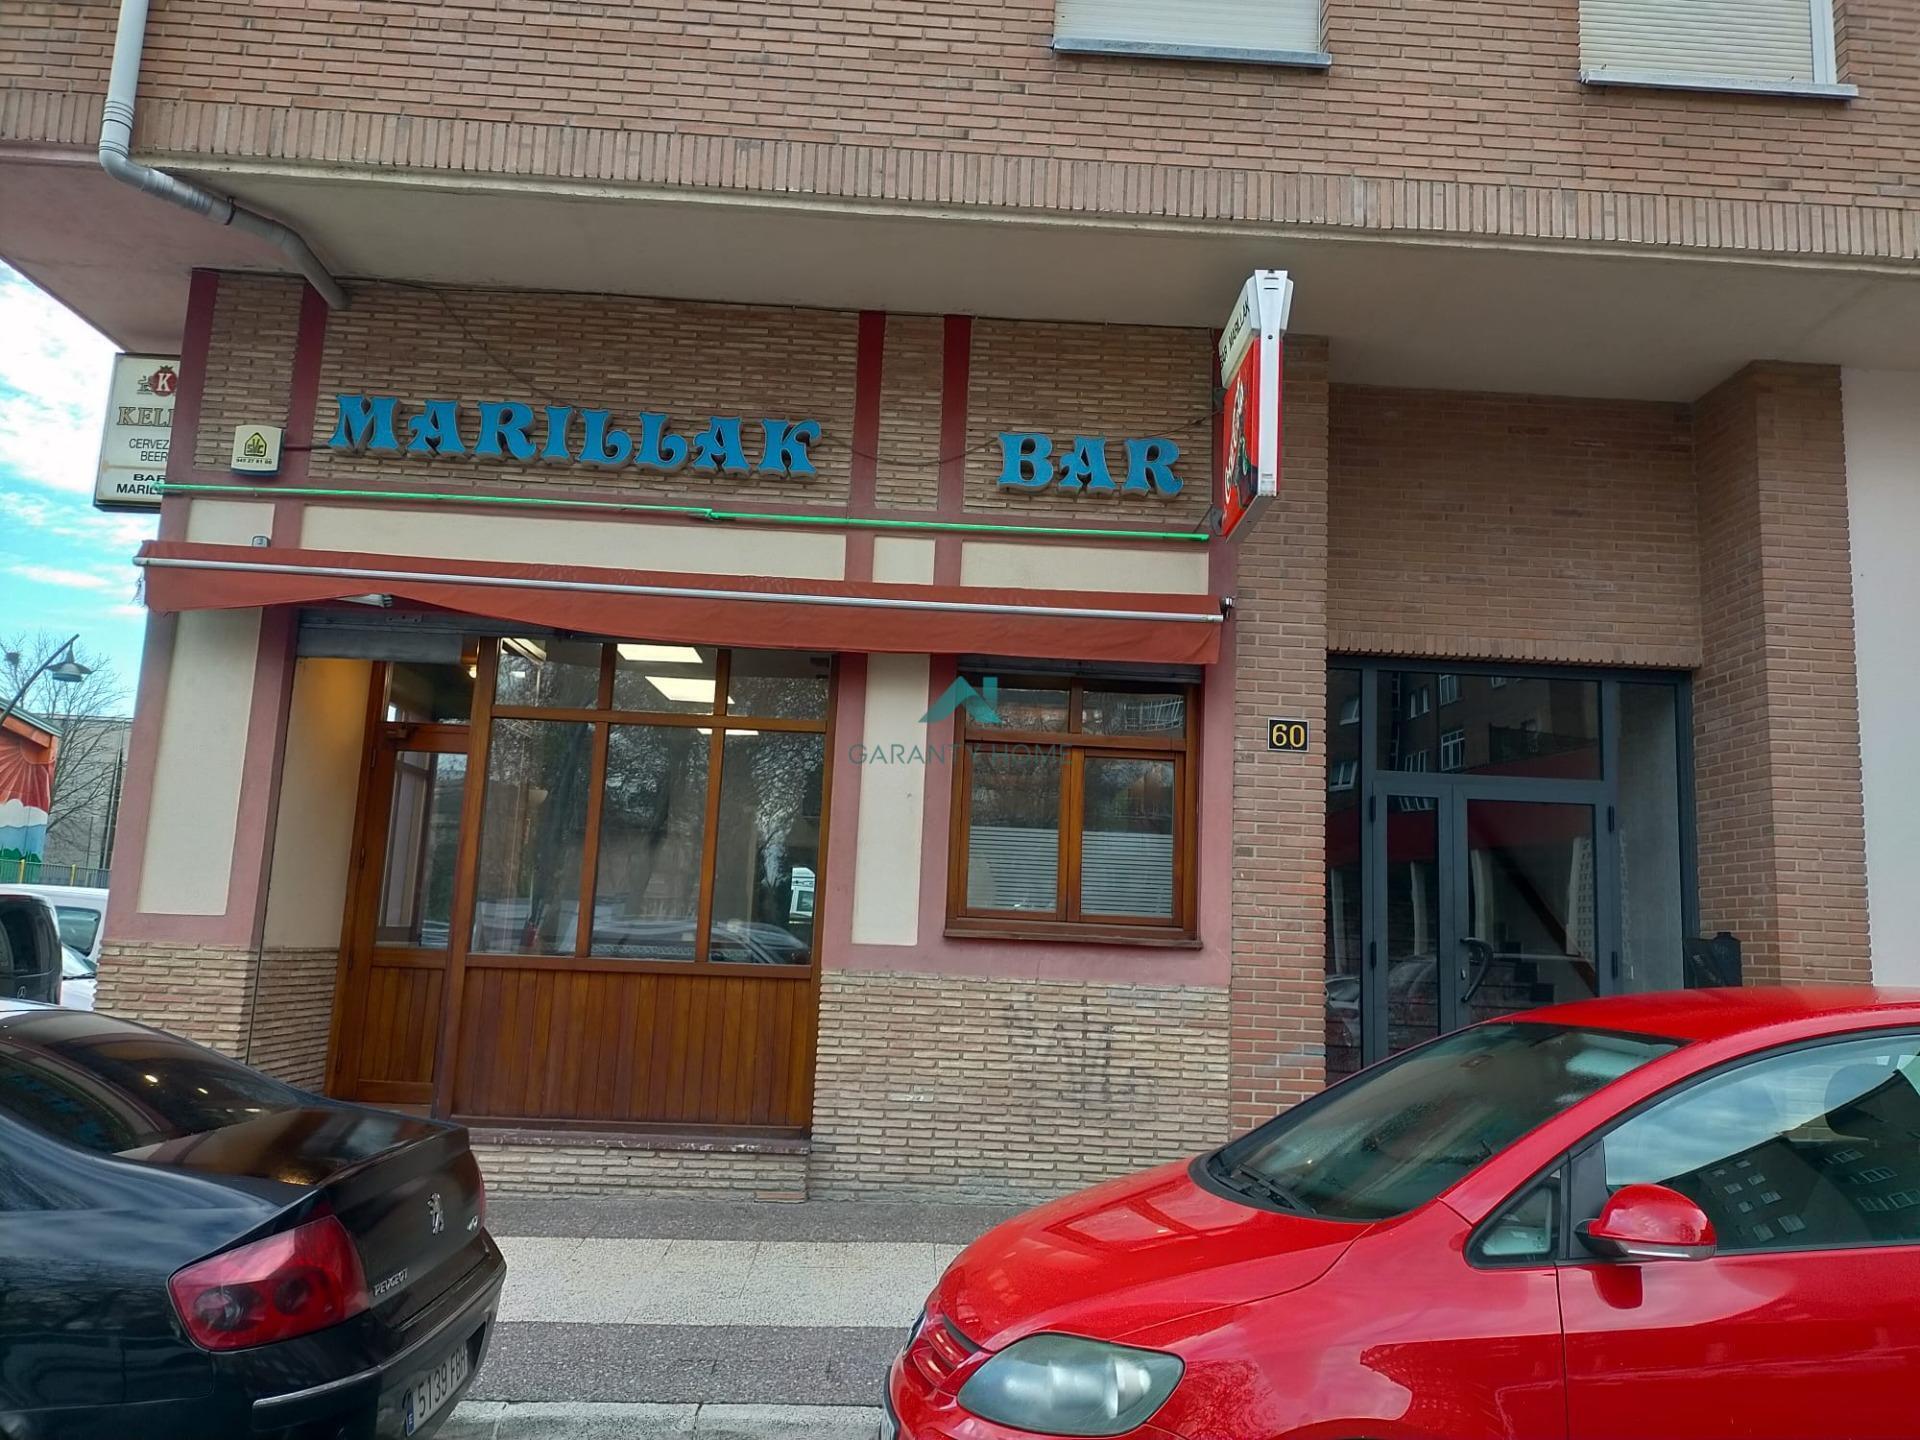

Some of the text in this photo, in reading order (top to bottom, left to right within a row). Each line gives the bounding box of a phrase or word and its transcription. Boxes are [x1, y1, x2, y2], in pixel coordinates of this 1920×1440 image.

[156, 373, 171, 391] K
[327, 395, 824, 480] MARILLAK
[996, 431, 1185, 500] BAR
[1272, 723, 1305, 748] 60
[374, 1267, 408, 1297] PEUGEOT
[417, 1363, 447, 1418] 5139
